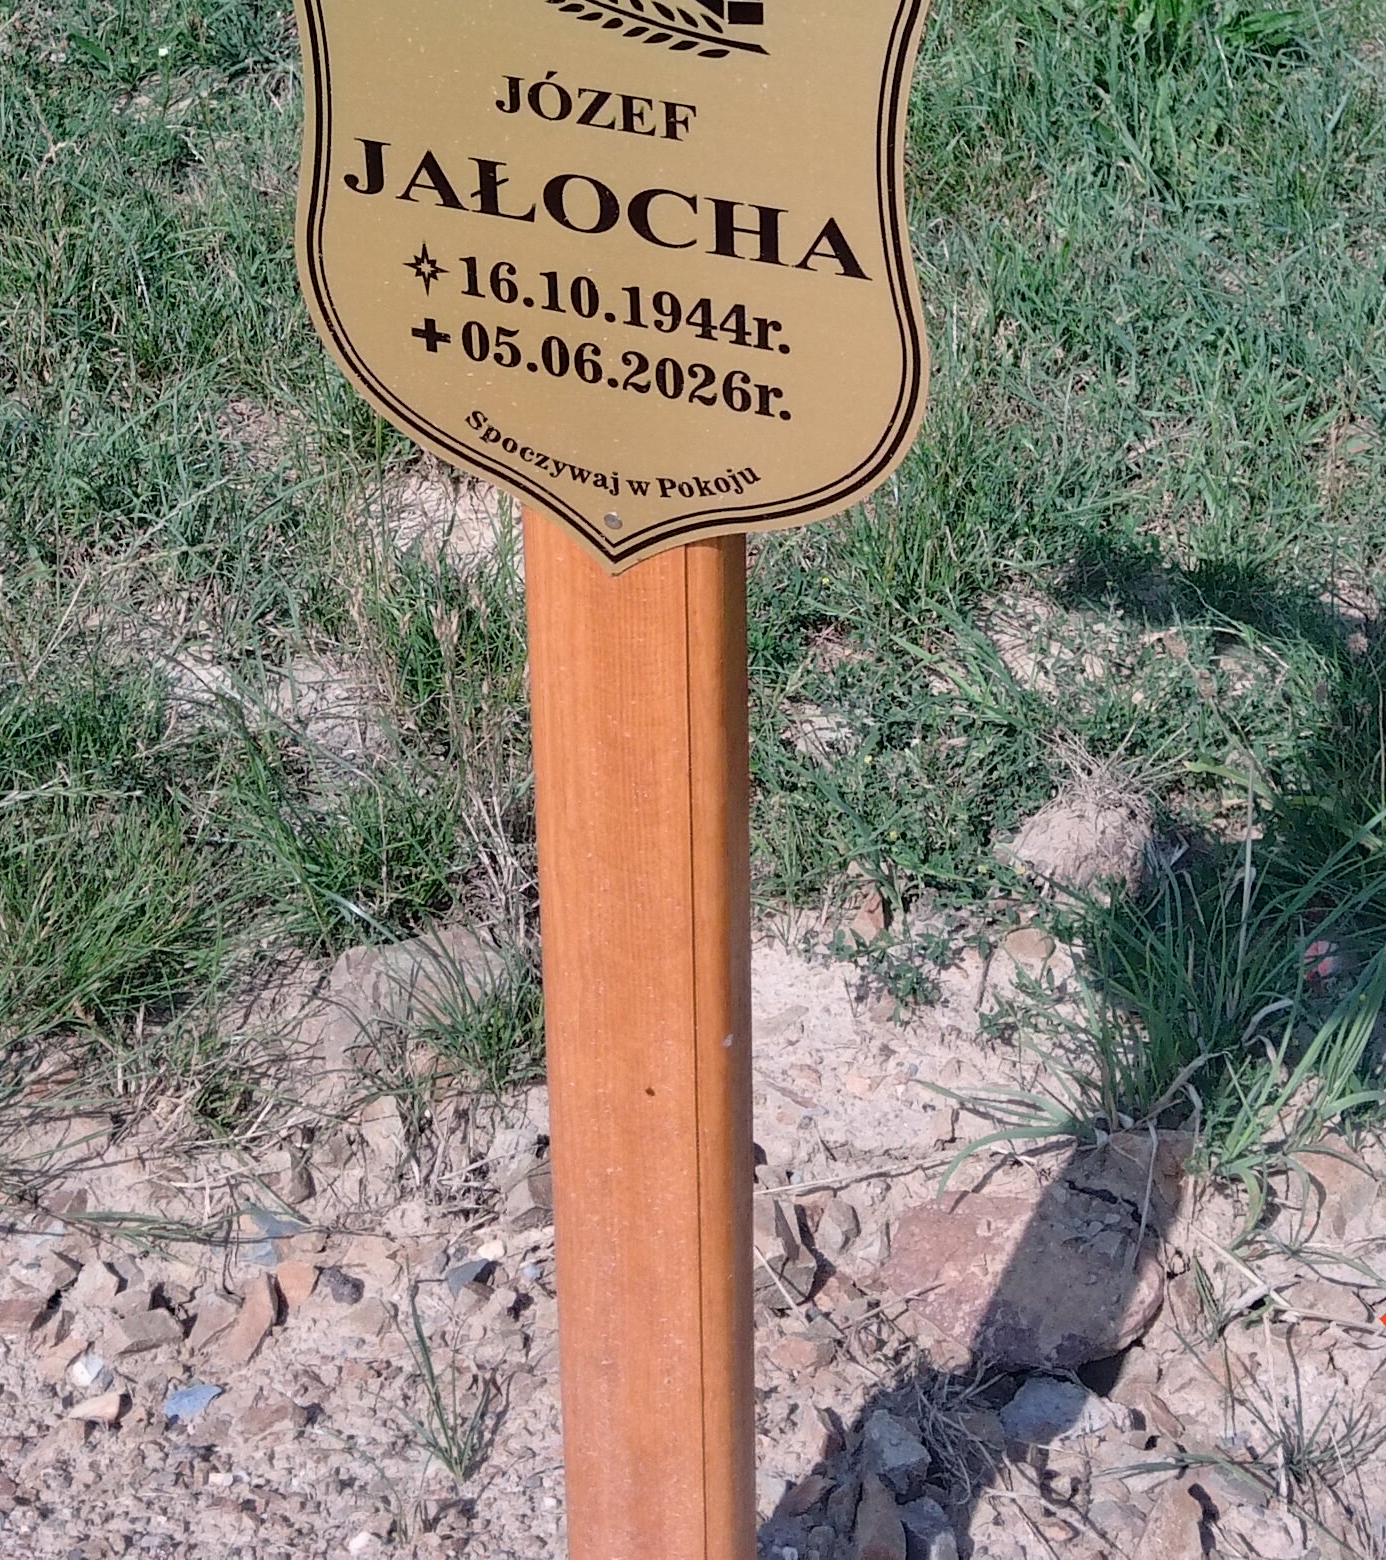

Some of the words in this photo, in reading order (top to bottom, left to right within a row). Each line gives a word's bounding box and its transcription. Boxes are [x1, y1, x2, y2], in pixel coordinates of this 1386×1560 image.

[495, 70, 697, 142] JÓZEF
[343, 137, 873, 281] JAŁOCHA
[458, 256, 791, 355] 16.10.1944r.
[464, 409, 620, 497] Spoczywaj
[625, 479, 651, 497] w
[655, 465, 762, 499] Pokoju
